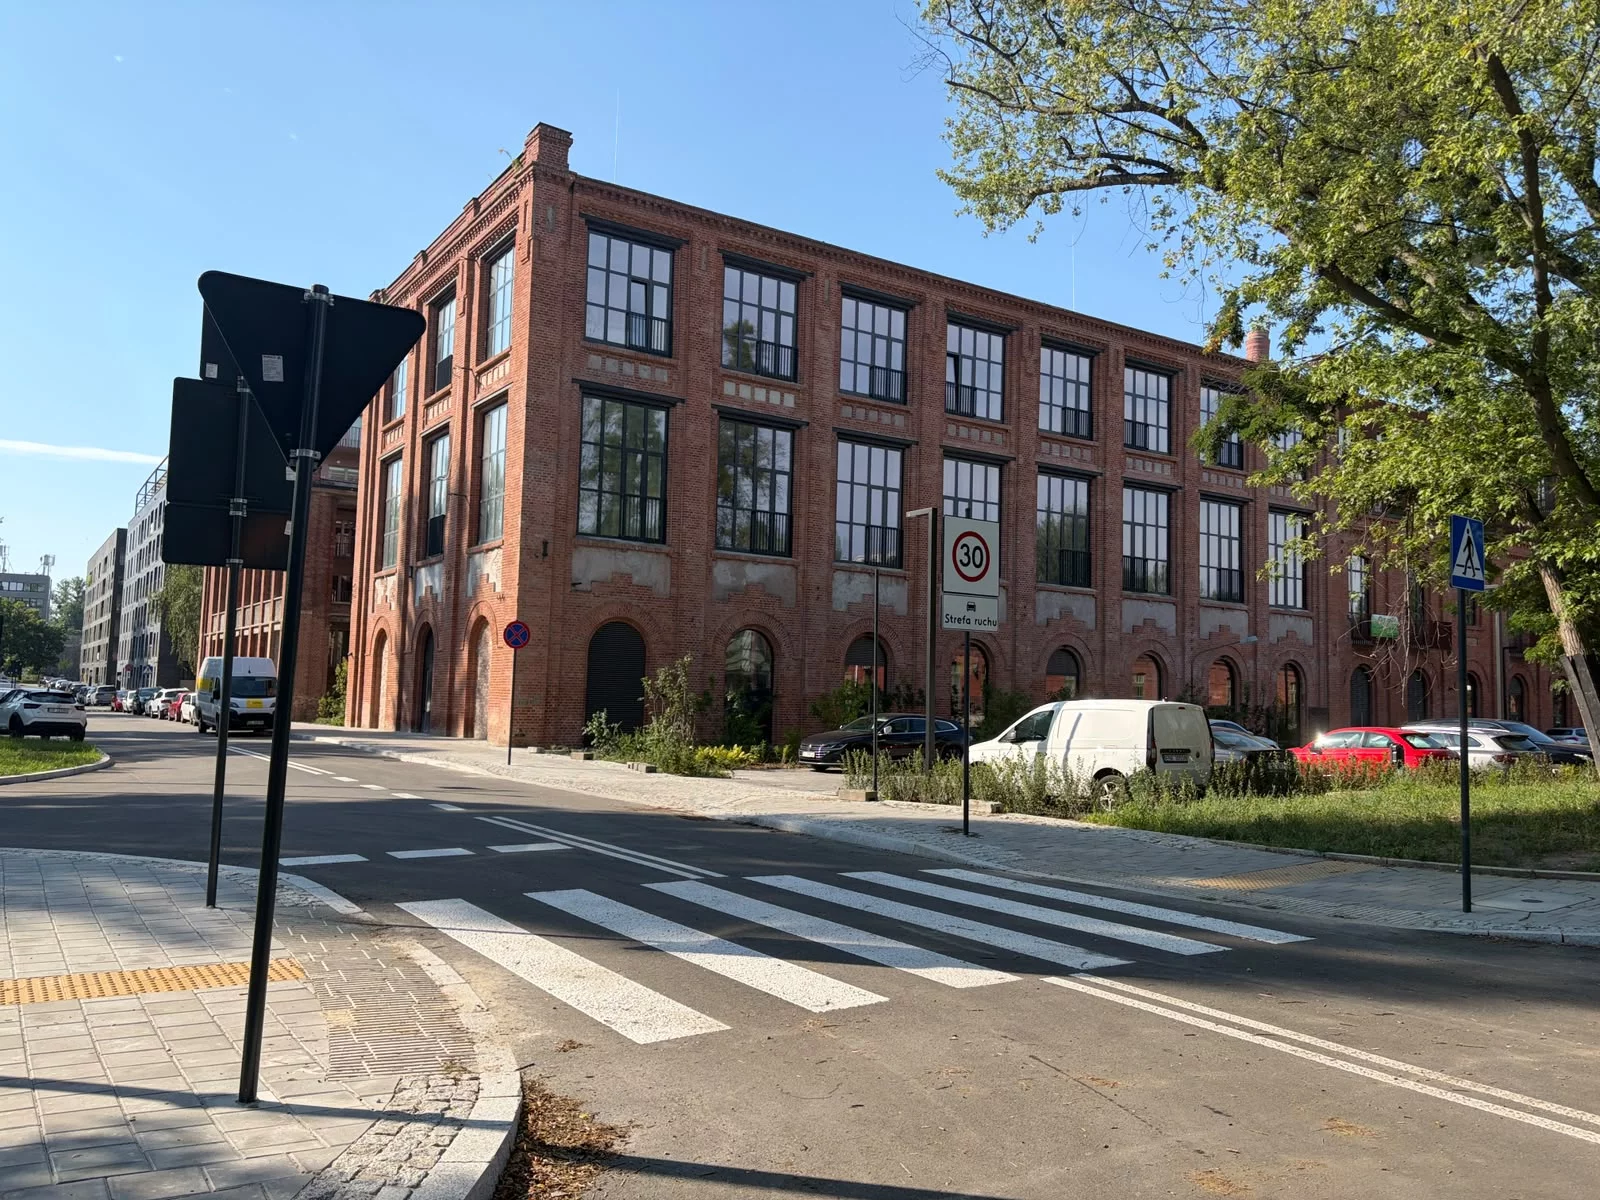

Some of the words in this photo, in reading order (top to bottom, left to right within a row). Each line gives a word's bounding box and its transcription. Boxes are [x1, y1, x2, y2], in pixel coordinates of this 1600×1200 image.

[959, 543, 984, 568] 30
[944, 613, 971, 625] Strefa
[974, 616, 997, 627] ruchu
